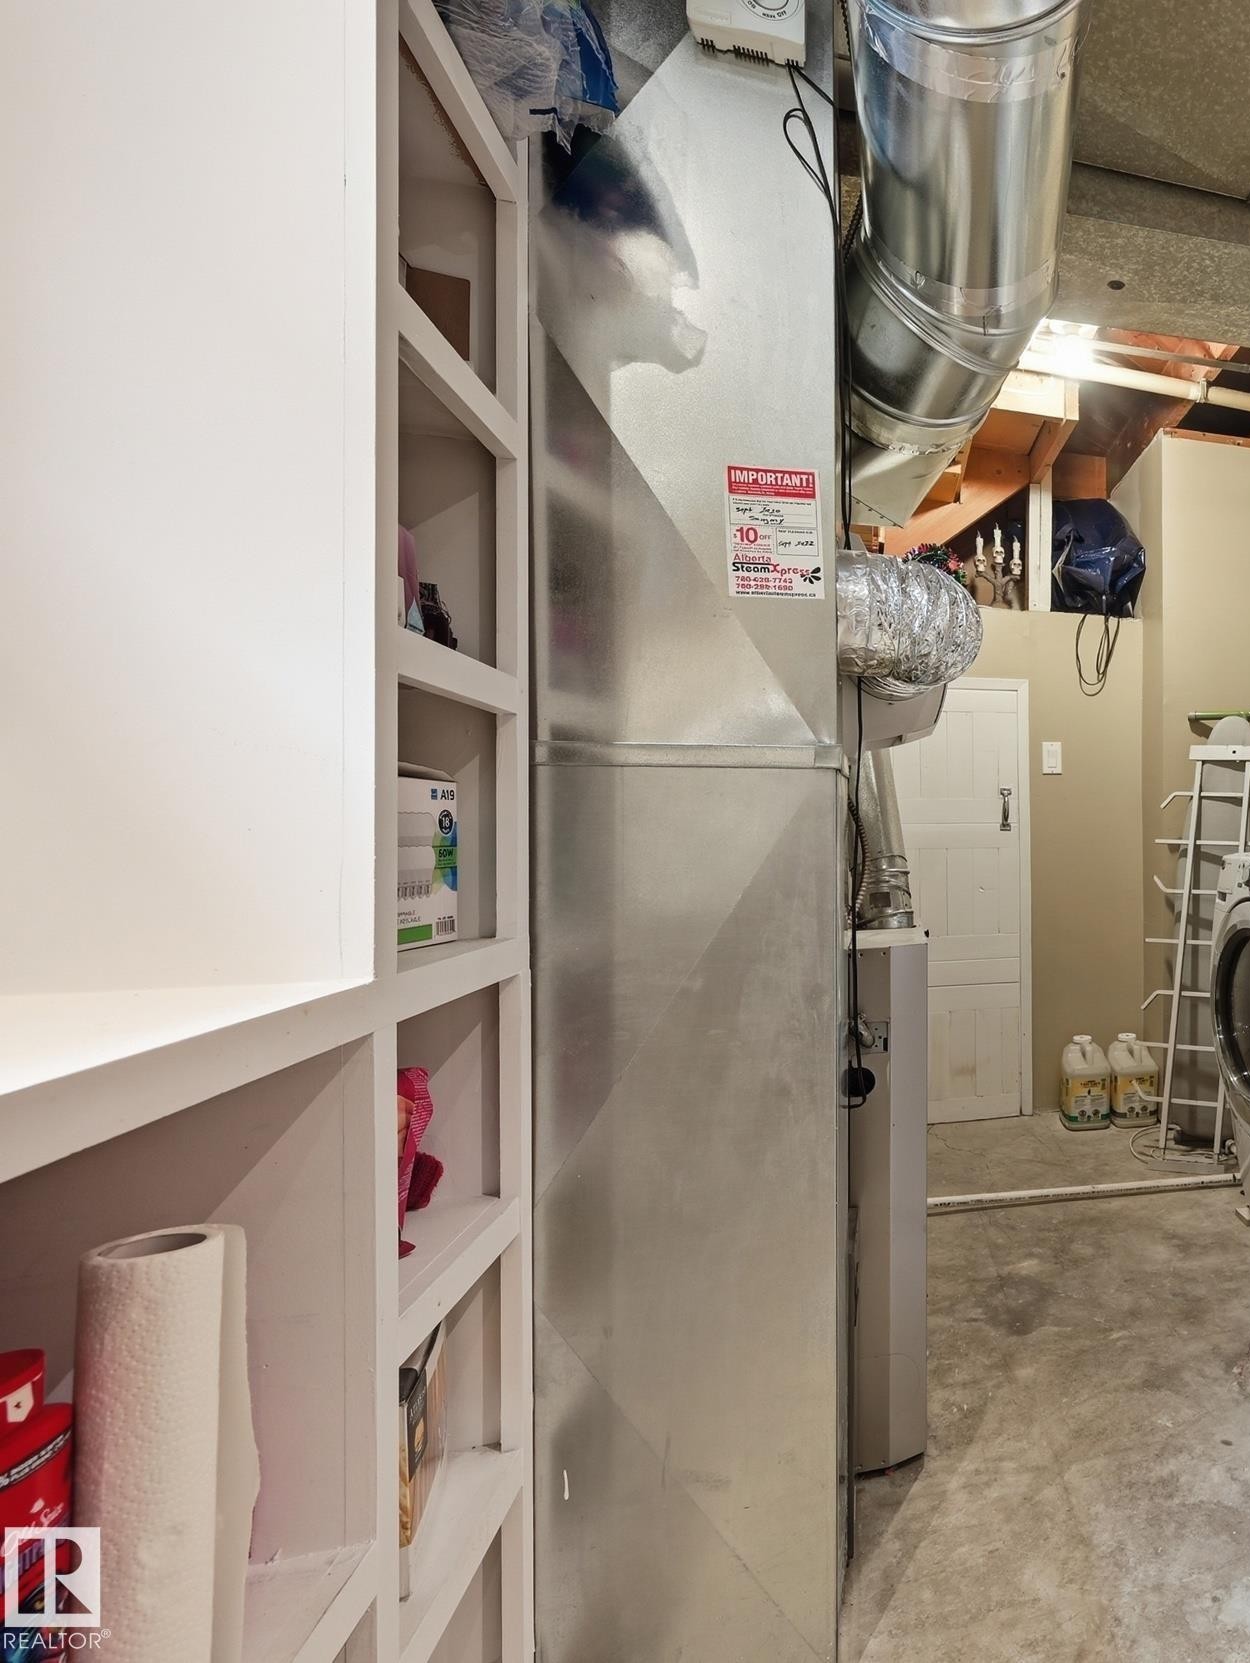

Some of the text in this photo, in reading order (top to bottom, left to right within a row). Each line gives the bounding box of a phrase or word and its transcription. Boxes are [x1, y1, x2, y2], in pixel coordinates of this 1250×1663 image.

[730, 469, 814, 487] IMPORTANT!
[733, 553, 772, 563] Alberta
[441, 789, 455, 801] A19
